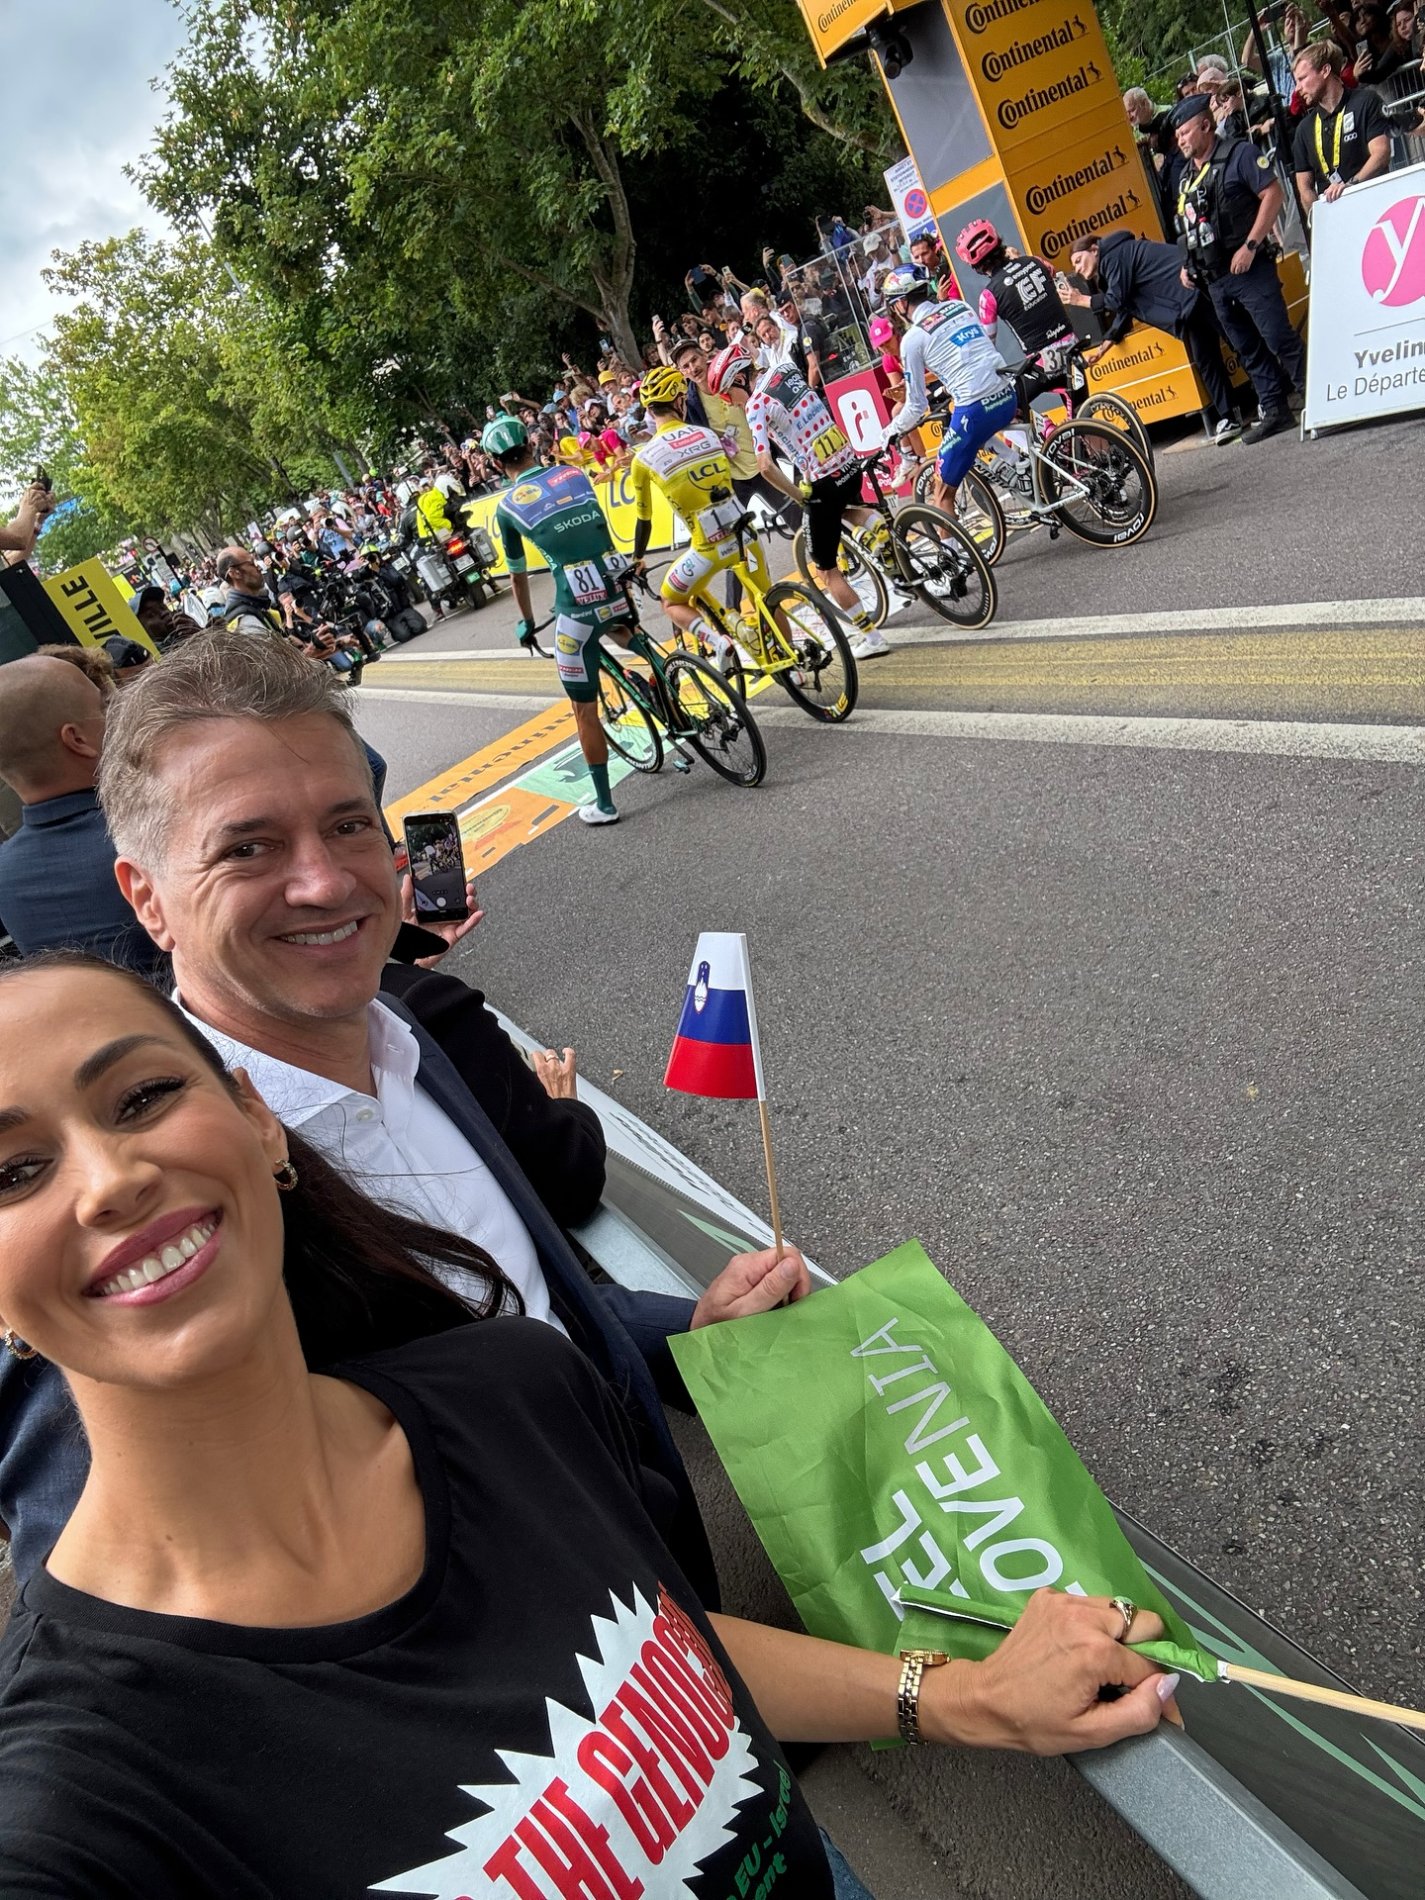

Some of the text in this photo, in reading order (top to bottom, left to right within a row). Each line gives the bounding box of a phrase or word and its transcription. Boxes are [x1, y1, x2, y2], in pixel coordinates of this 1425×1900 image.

[981, 20, 1075, 83] Continental
[997, 66, 1090, 130] Continental
[1026, 151, 1115, 215] Continental
[1040, 195, 1128, 259] Continental
[1015, 267, 1047, 304] EF
[1024, 292, 1048, 311] Education
[956, 327, 980, 343] Krys
[1354, 339, 1425, 369] Yvelin
[1090, 345, 1155, 382] Continental
[1326, 383, 1347, 401] Le
[677, 440, 712, 457] XRG
[609, 468, 636, 508] LC
[689, 463, 727, 482] LCL
[574, 566, 600, 594] 81
[850, 1317, 1088, 1597] OVENIA
[482, 1775, 646, 1900] THE
[734, 1842, 761, 1899] EU
[752, 1851, 788, 1900] ent
